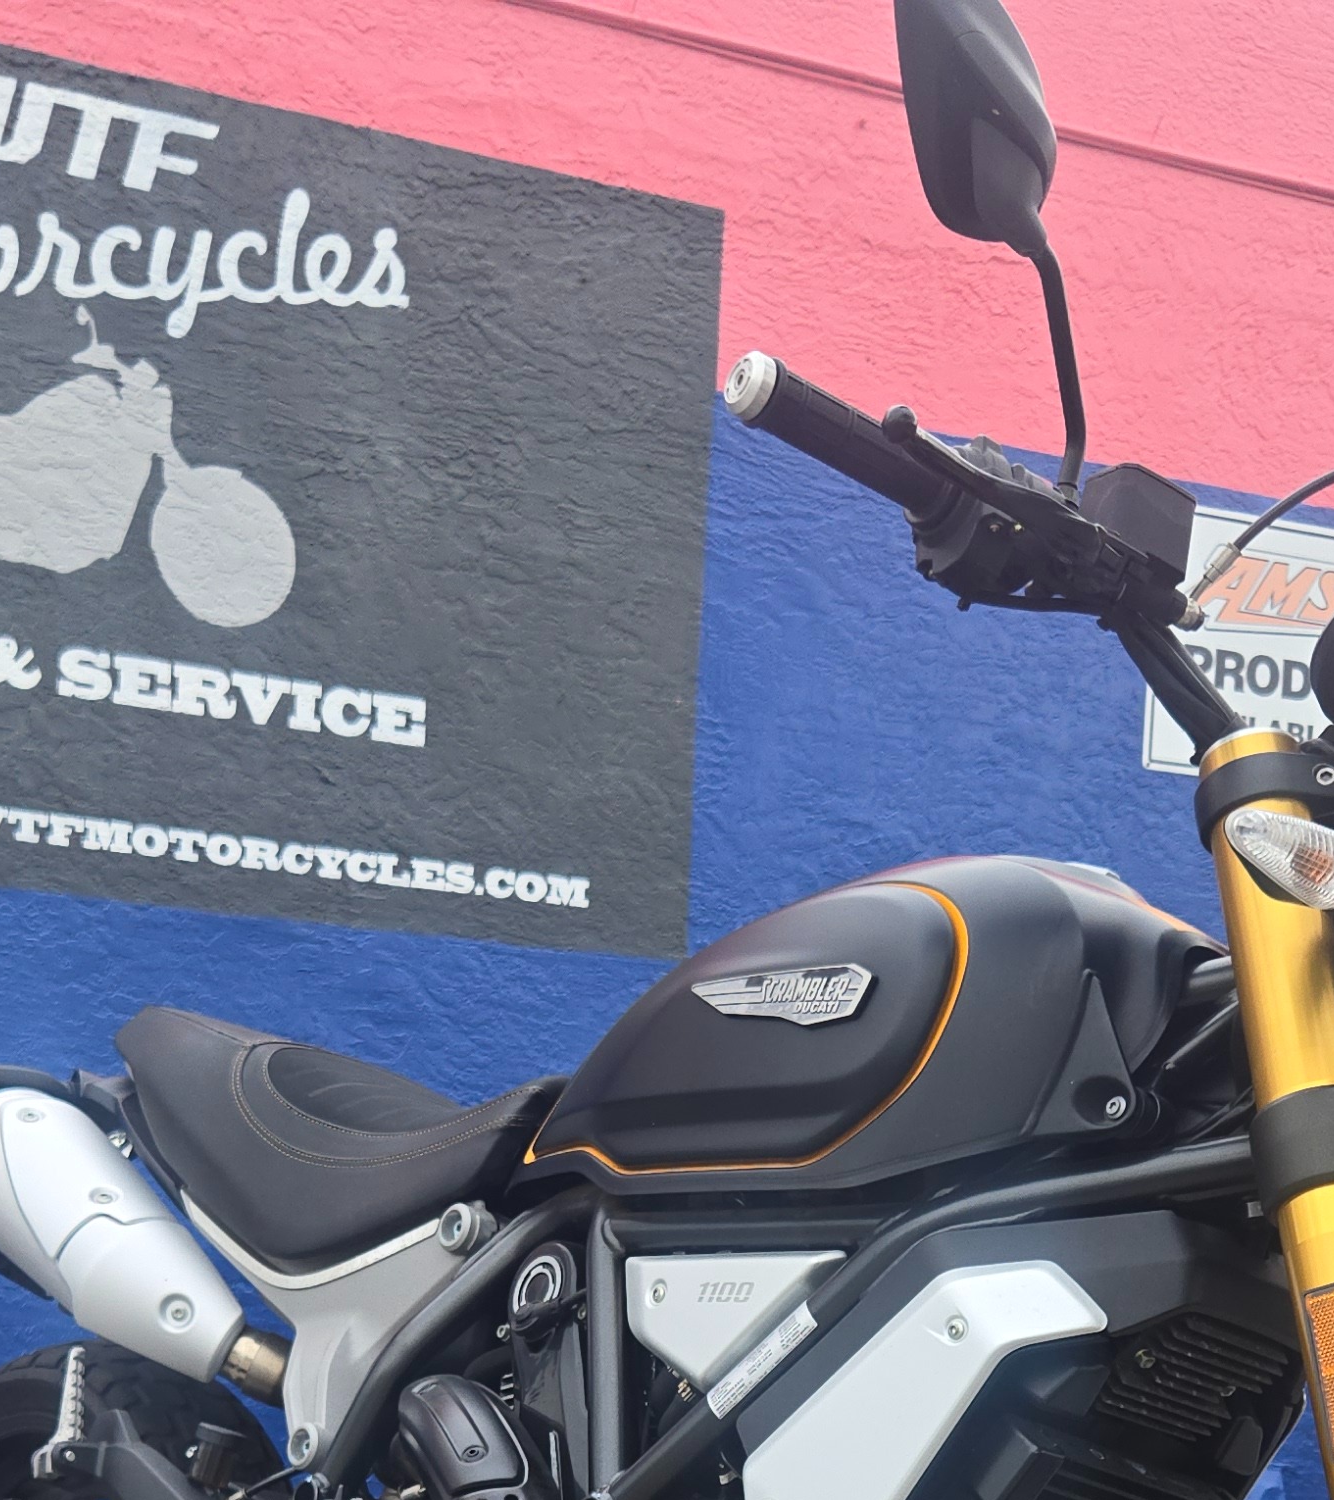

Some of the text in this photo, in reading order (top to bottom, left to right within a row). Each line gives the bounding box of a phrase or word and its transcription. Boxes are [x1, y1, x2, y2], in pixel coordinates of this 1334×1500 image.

[1184, 643, 1311, 701] PROD
[56, 647, 427, 748] SERVICE
[761, 976, 851, 1004] SCRAMBLER
[793, 1001, 840, 1014] DUCATI
[697, 1281, 755, 1303] 1100
